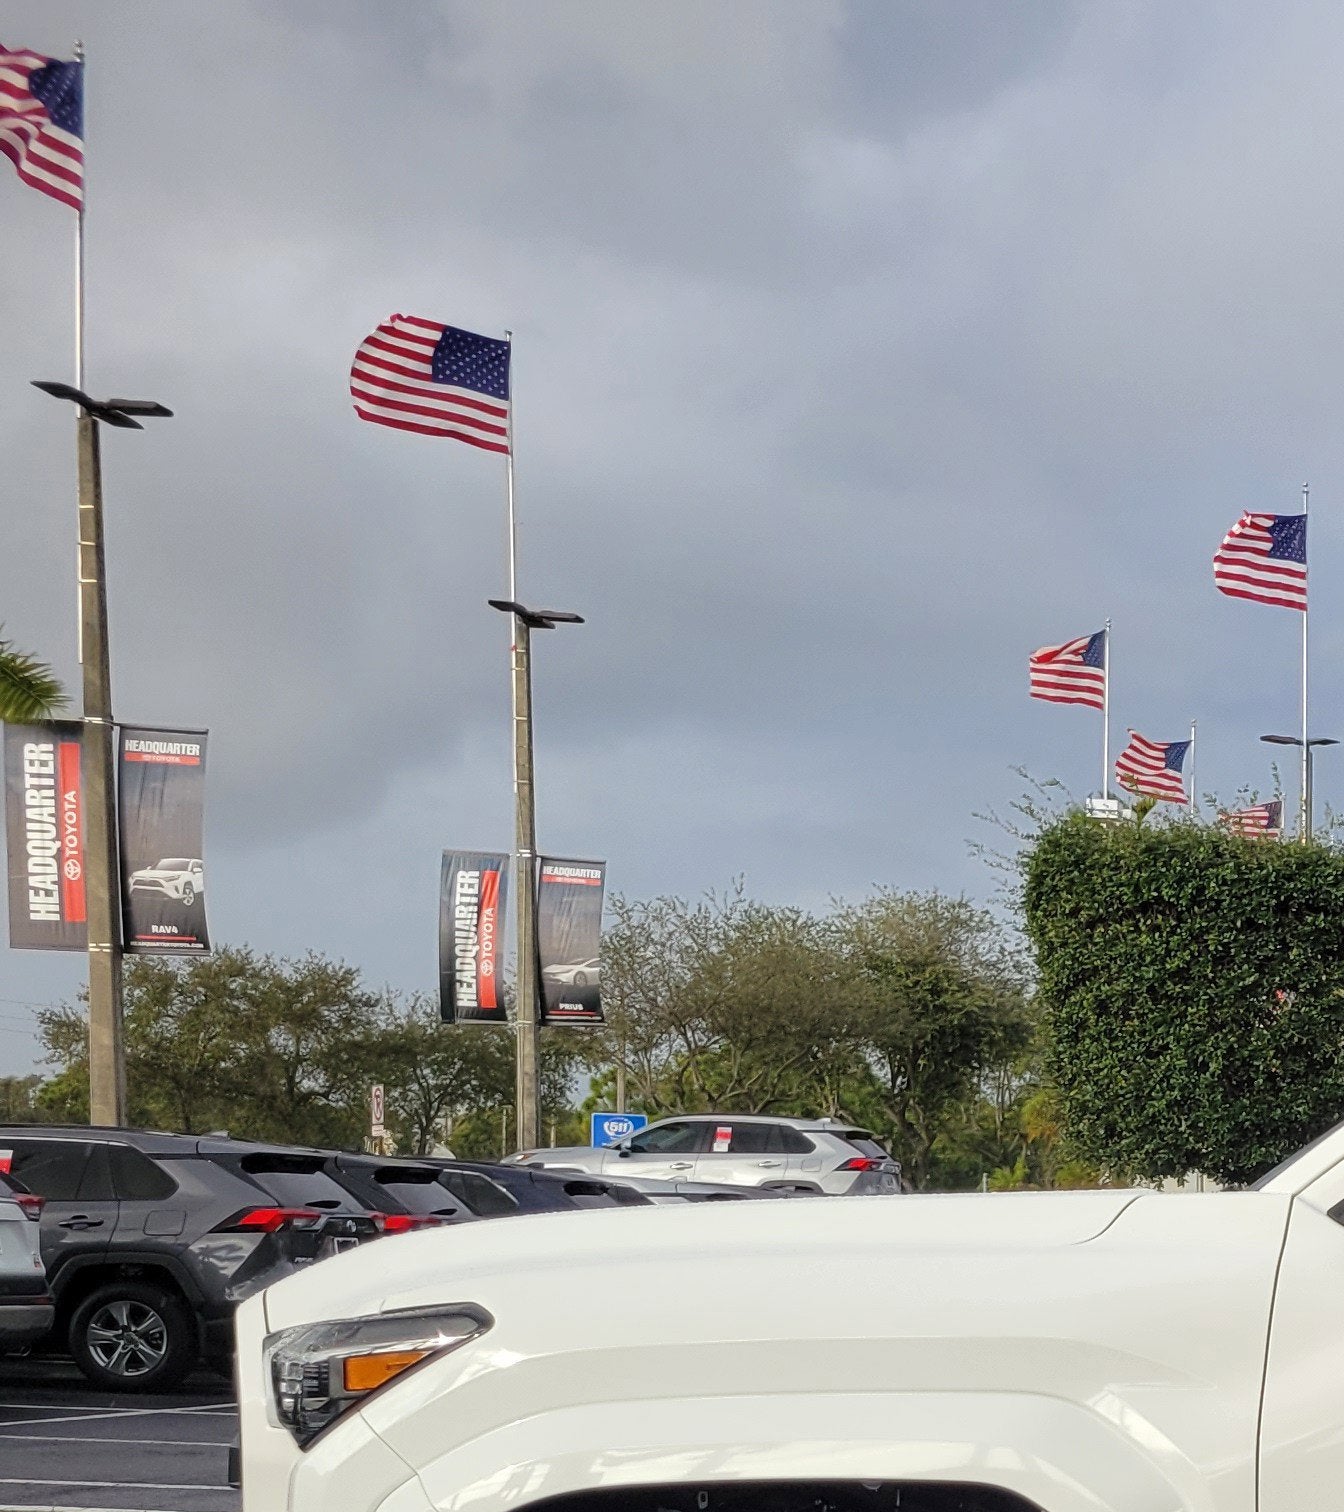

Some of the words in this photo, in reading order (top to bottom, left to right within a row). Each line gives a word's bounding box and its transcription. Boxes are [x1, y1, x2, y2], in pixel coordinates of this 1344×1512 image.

[125, 740, 200, 755] HEADQUARTER
[64, 790, 79, 857] TOYOTA
[24, 742, 61, 921] HEADQUARTER
[543, 865, 601, 879] HEADQUARTER
[151, 925, 179, 934] RAV4
[482, 907, 495, 958] TOYOTA
[454, 870, 481, 1007] HEADQUARTER
[559, 1003, 584, 1011] PRIUS
[609, 1121, 628, 1133] 511
